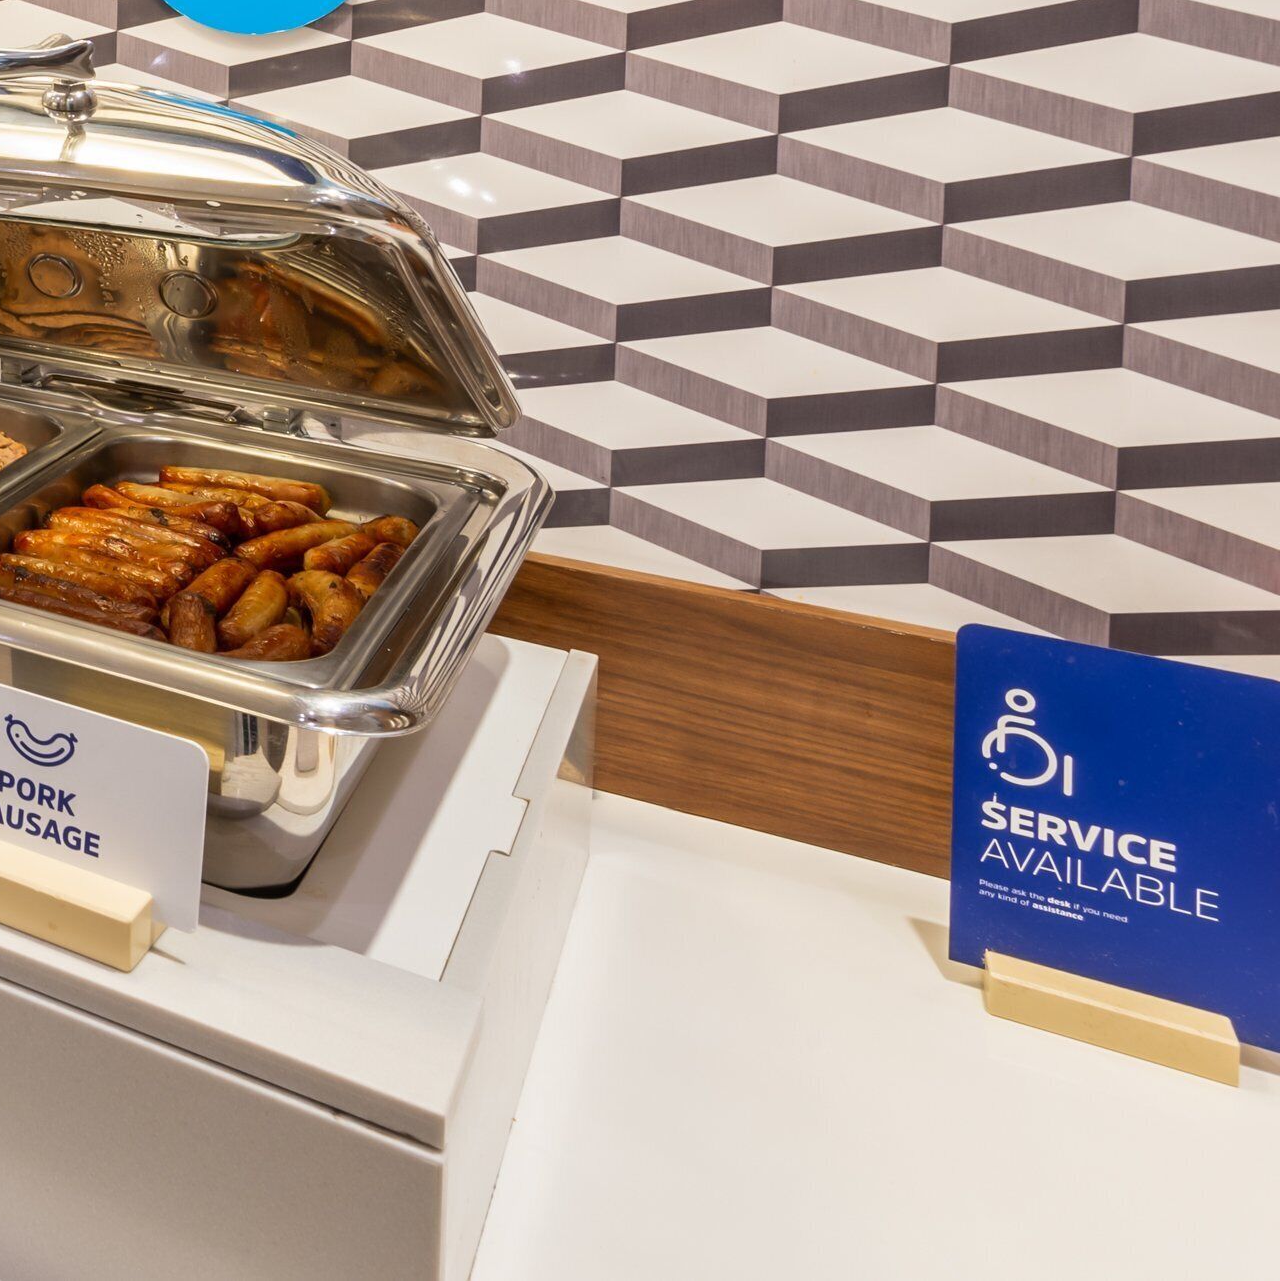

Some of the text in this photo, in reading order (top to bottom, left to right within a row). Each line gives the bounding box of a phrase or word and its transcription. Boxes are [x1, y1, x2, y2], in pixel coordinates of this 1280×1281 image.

[981, 800, 1177, 873] SERVICE
[979, 889, 995, 898] any
[998, 893, 1017, 904] kind
[1020, 897, 1029, 906] of
[979, 878, 1128, 923] Please ask the desk if you need
[980, 838, 1220, 922] AVAILABLE
